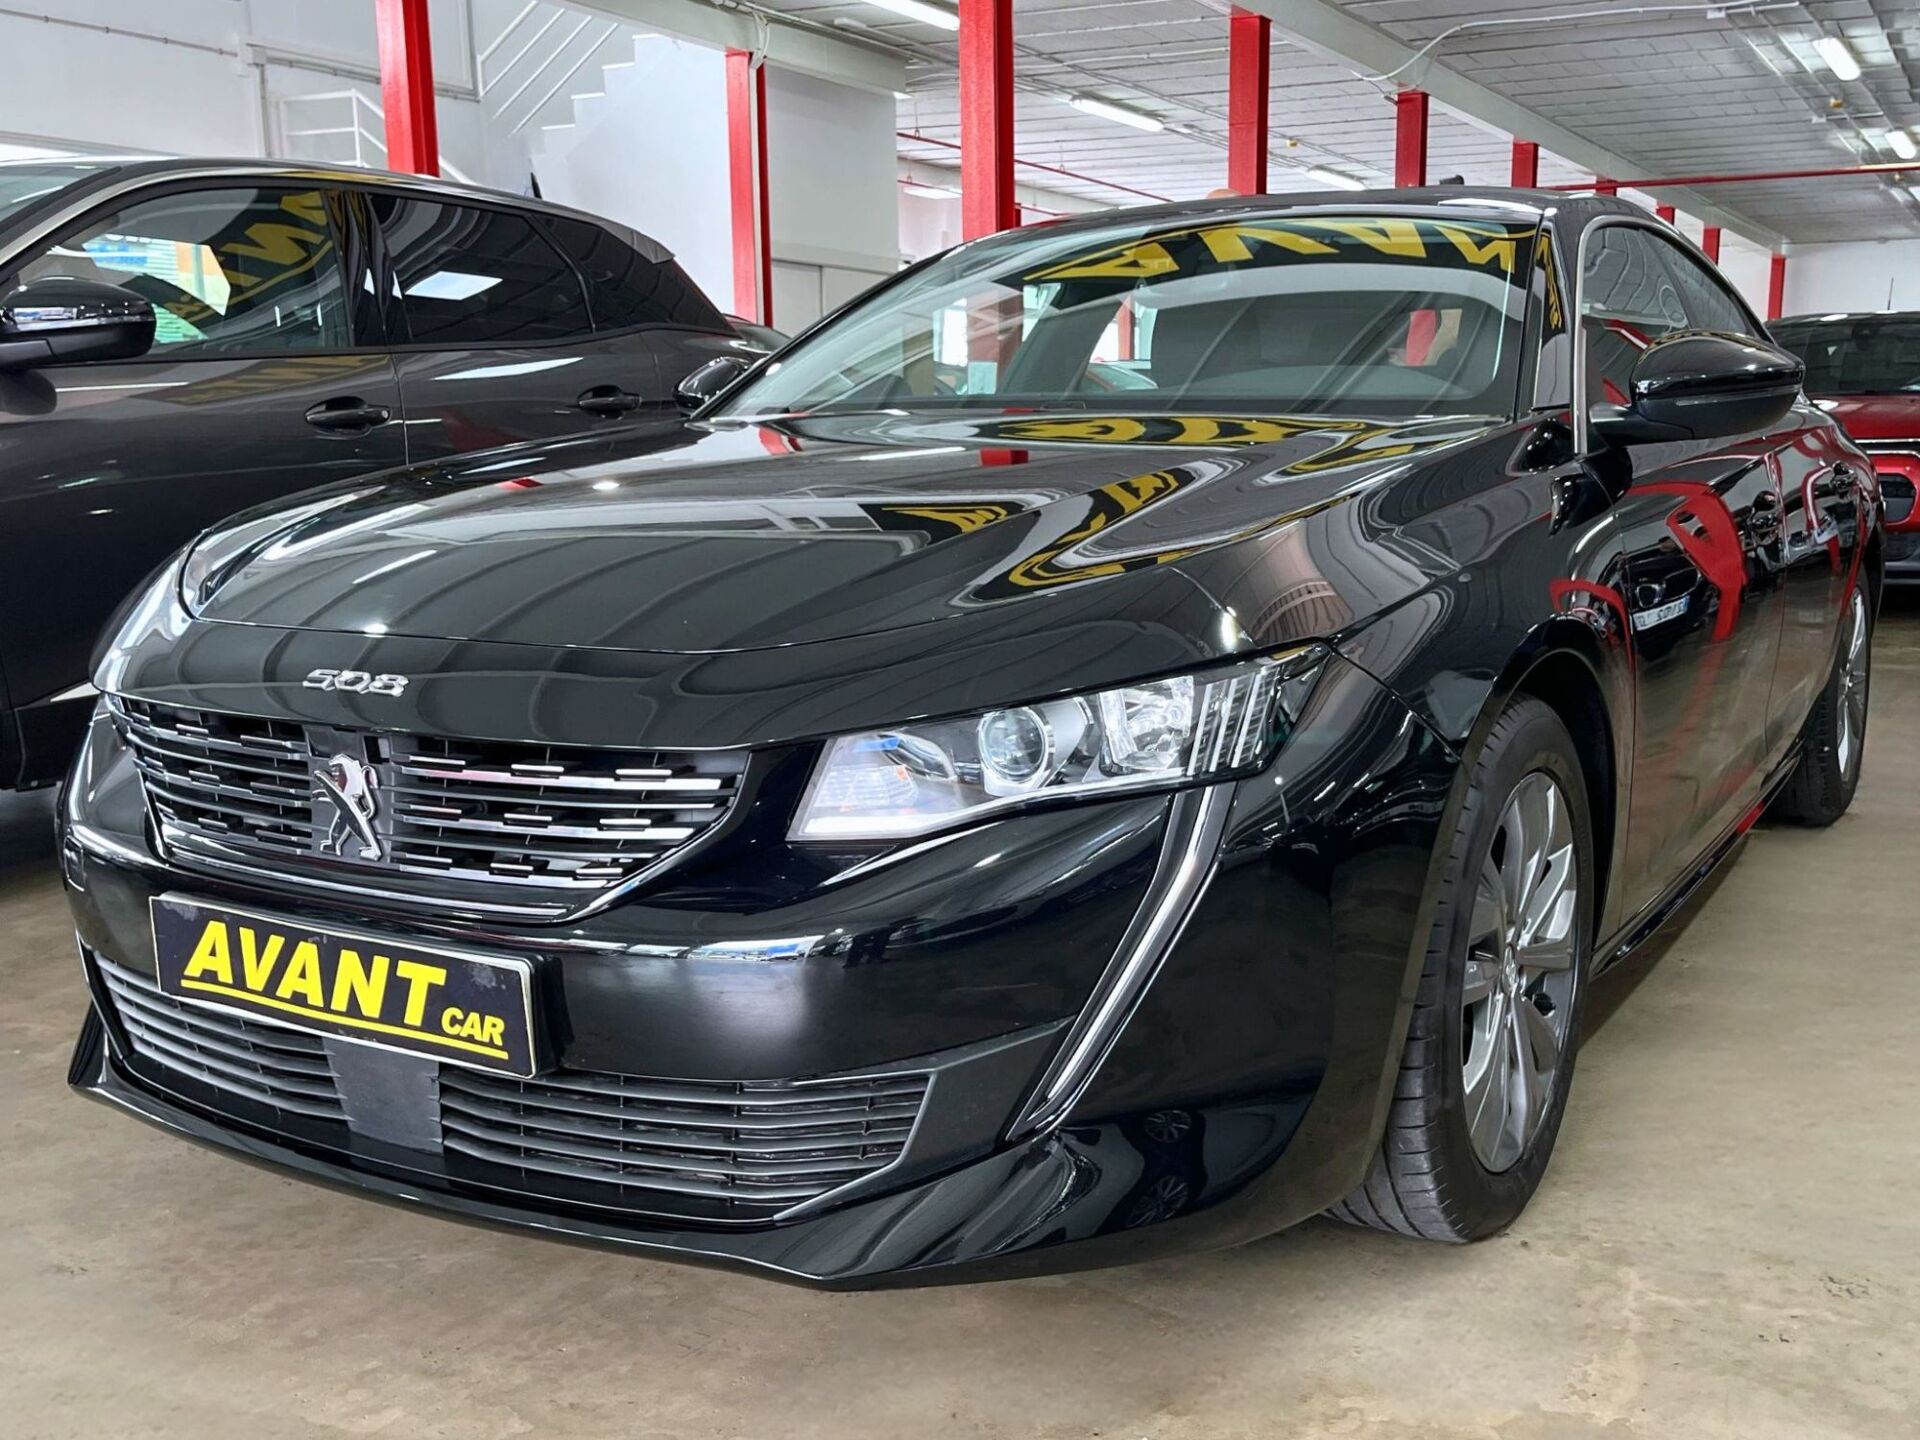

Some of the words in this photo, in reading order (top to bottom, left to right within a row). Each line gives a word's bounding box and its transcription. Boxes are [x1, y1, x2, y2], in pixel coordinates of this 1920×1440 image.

[302, 668, 409, 697] 508
[183, 919, 447, 1028] AVANT
[440, 1006, 505, 1047] CAR
